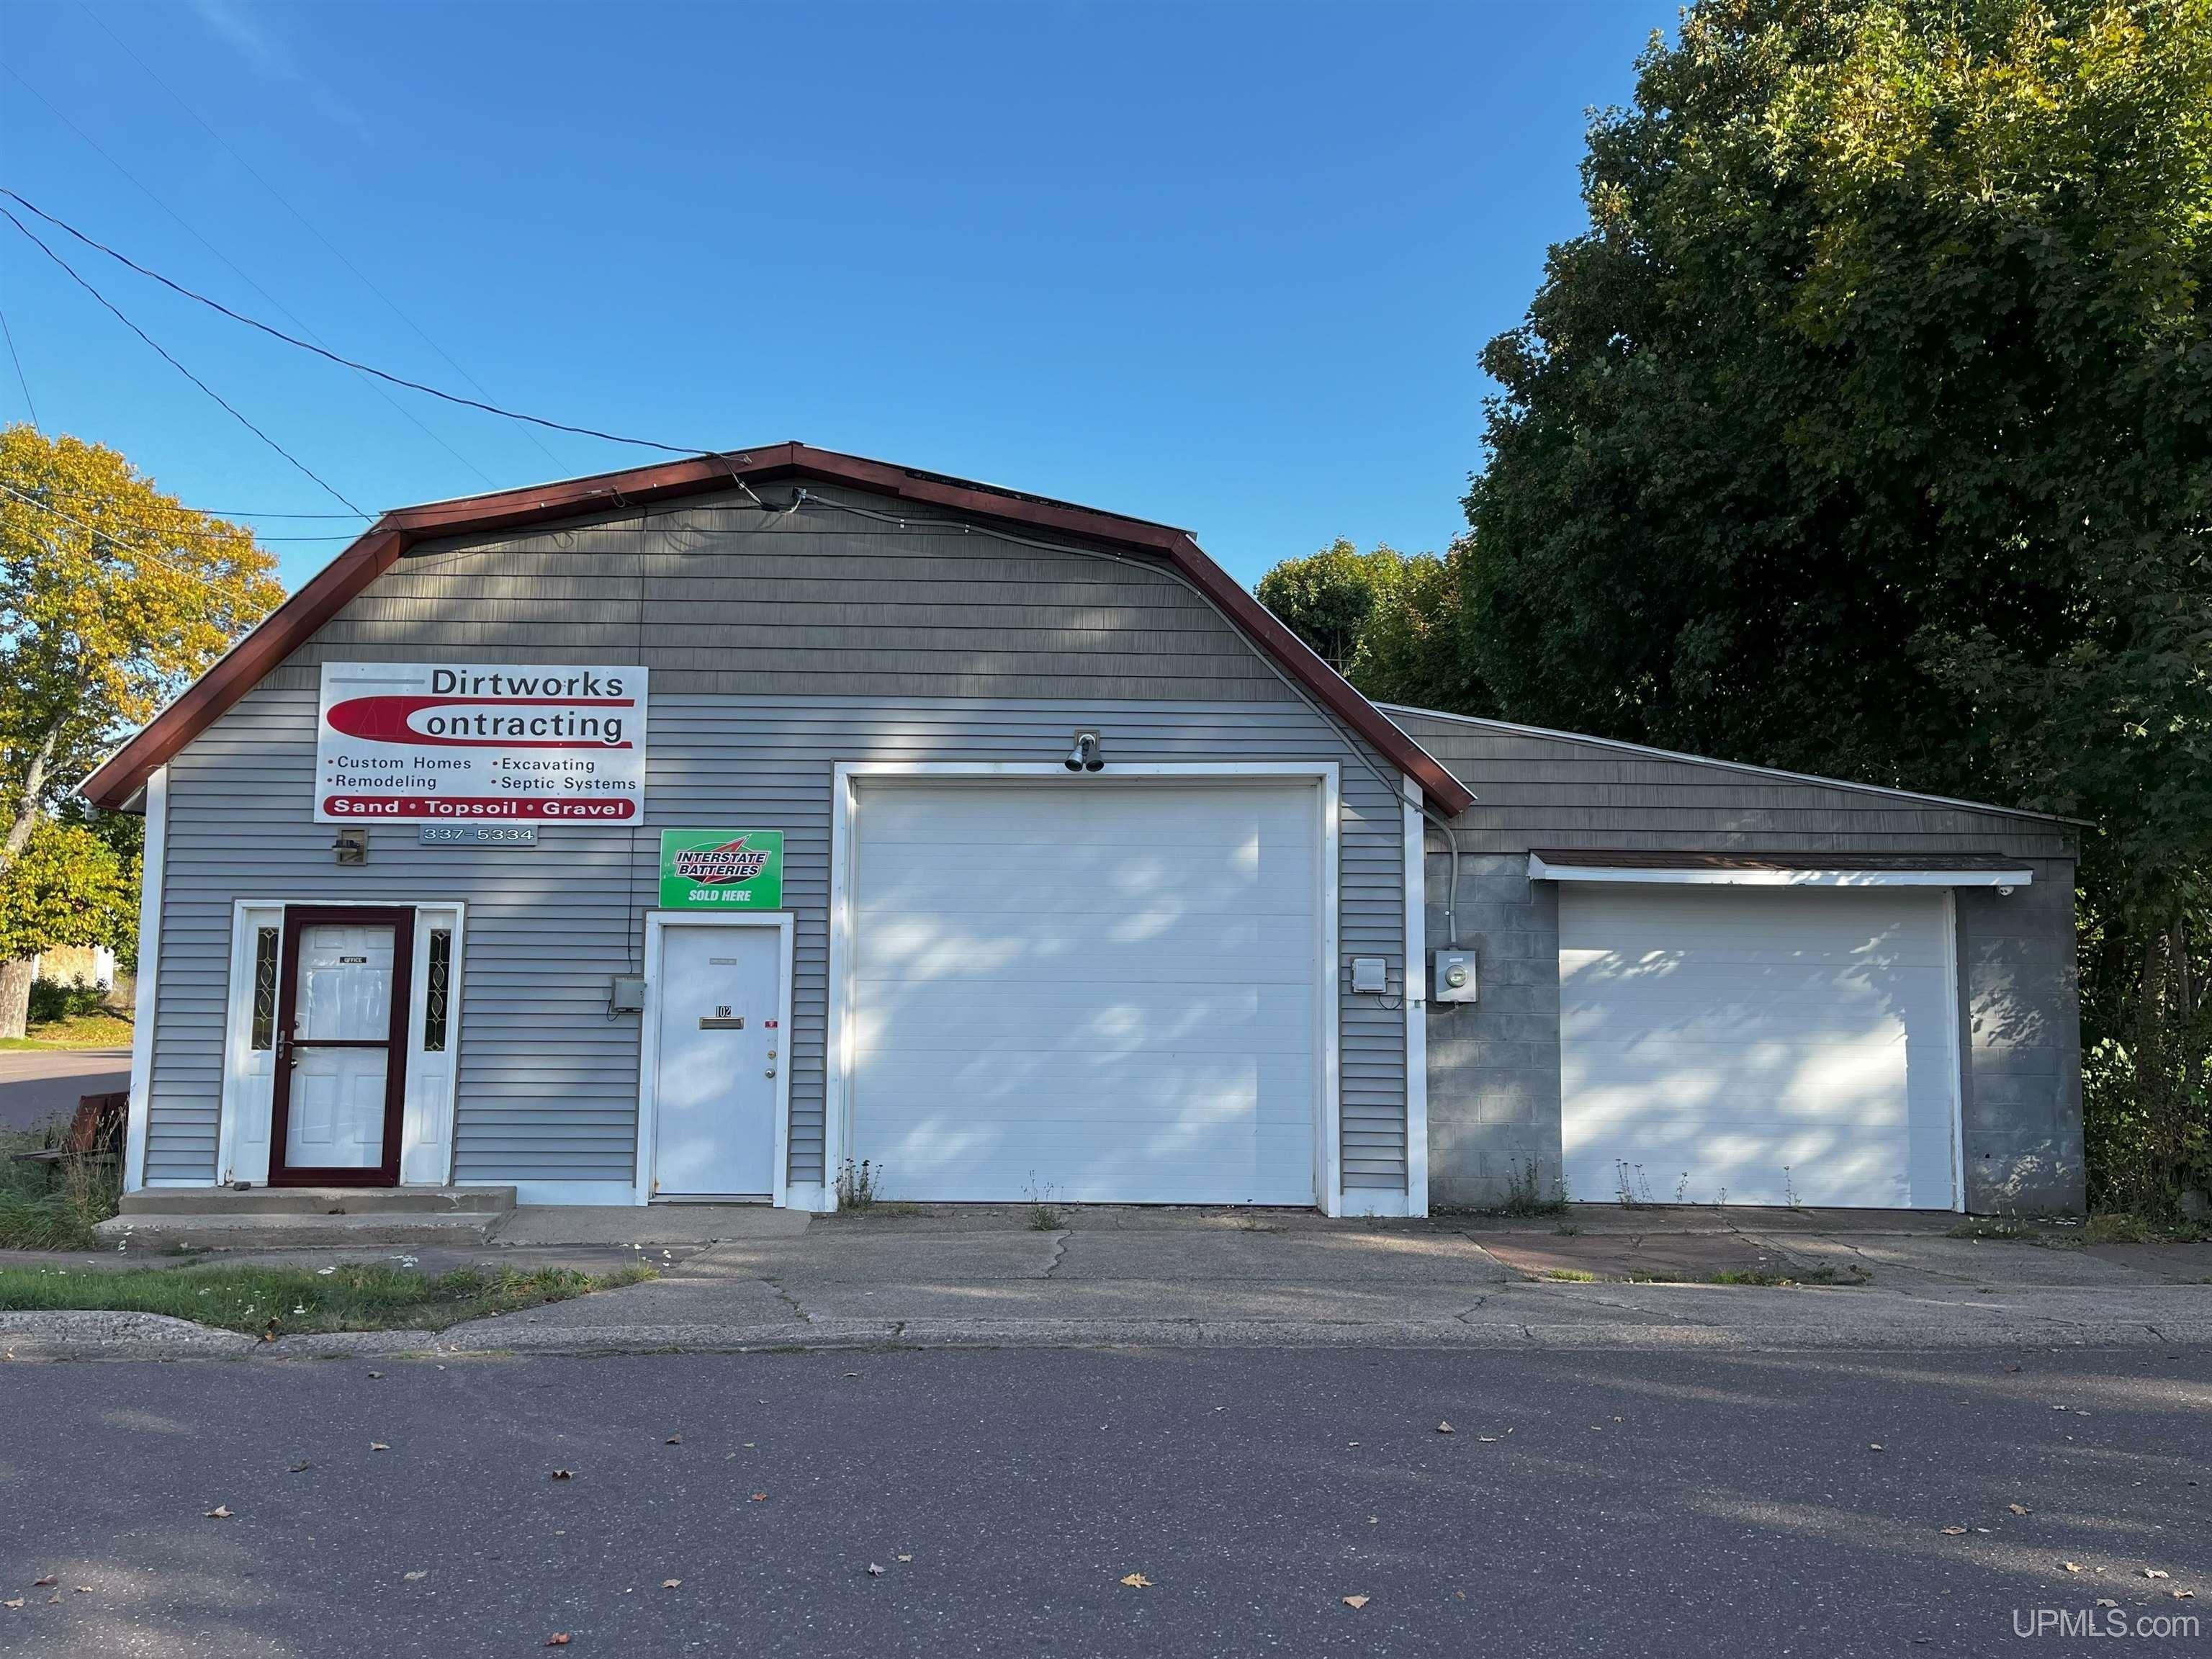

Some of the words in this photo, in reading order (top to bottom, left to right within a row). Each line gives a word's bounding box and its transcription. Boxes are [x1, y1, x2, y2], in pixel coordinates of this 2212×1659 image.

[431, 669, 624, 697] Dirtworks
[337, 755, 404, 769] Custom
[413, 757, 472, 769] Homes
[501, 757, 595, 773] Excavating
[336, 774, 437, 791] Remodeling
[501, 776, 555, 791] Septic
[564, 777, 637, 791] Systems
[333, 799, 399, 813] Sand
[424, 801, 517, 816] Topsoil
[542, 801, 624, 815] Gravel
[424, 829, 534, 840] 337-5334
[676, 852, 766, 863] INTERSTATE
[678, 865, 760, 876] BATTERIES
[688, 889, 719, 902] SOLD
[721, 890, 752, 902] HERE
[715, 1006, 732, 1017] 102
